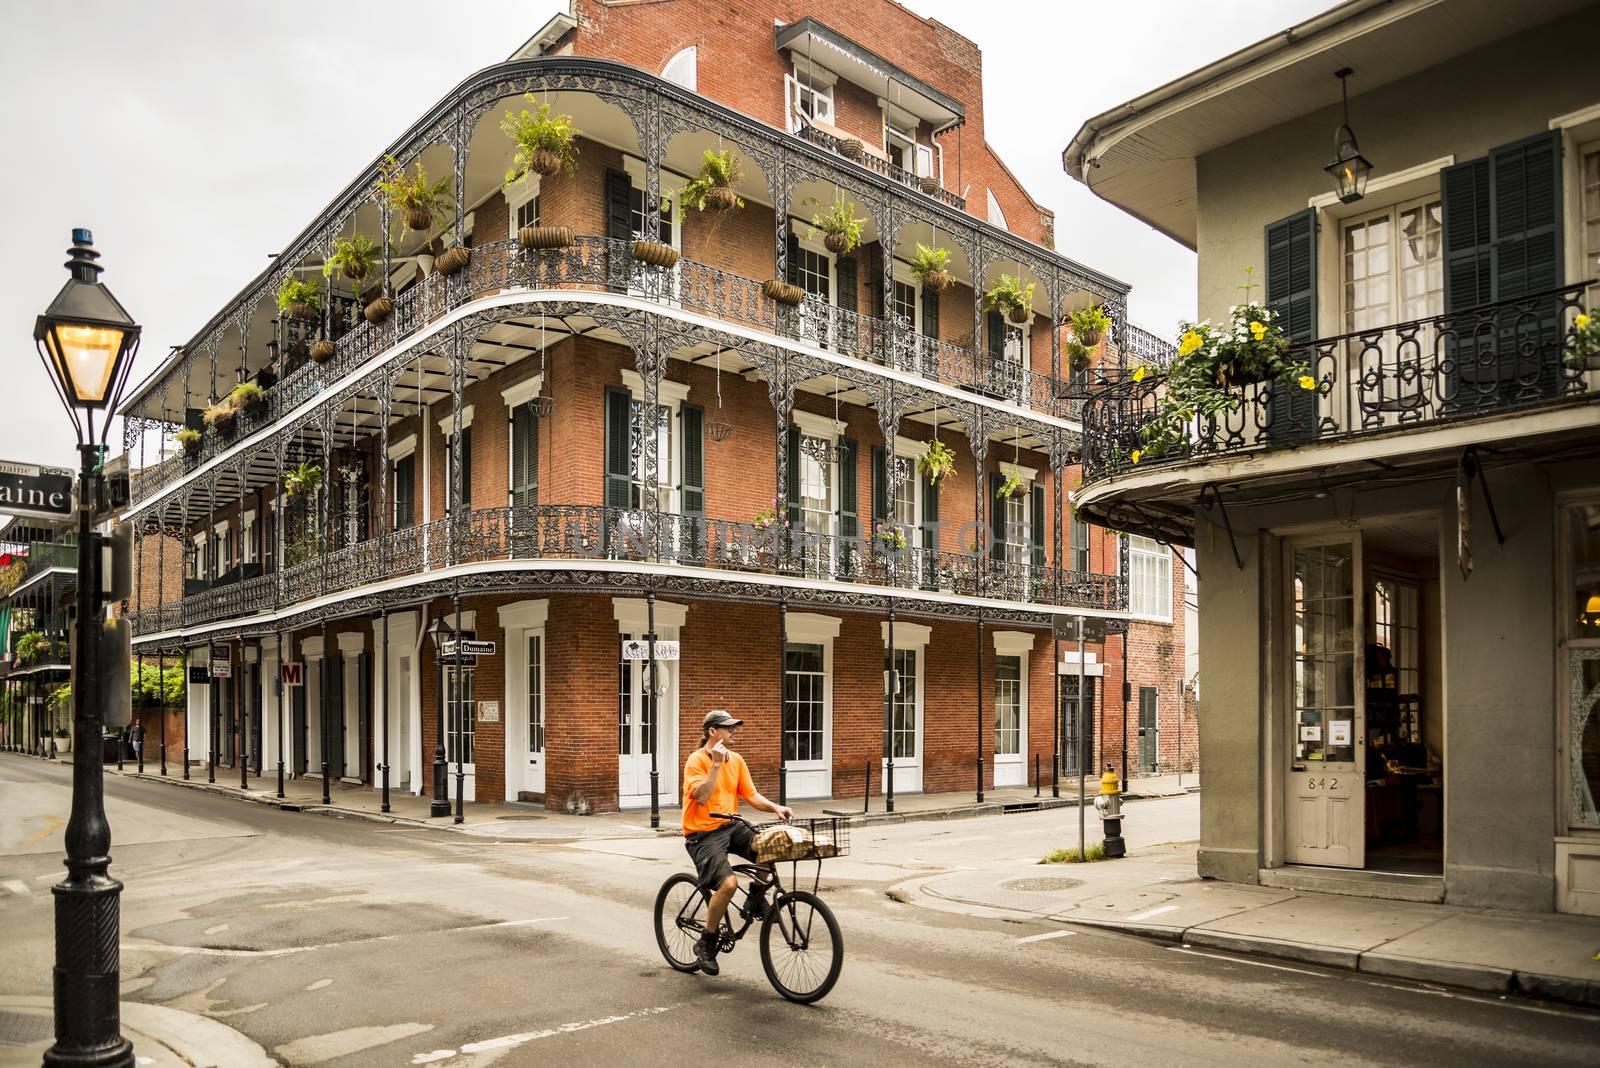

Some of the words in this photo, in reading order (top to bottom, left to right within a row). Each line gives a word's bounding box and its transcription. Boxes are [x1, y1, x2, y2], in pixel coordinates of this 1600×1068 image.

[0, 480, 64, 508] aine
[463, 645, 493, 653] Dumaine
[282, 665, 300, 683] M
[1308, 777, 1338, 790] 842
